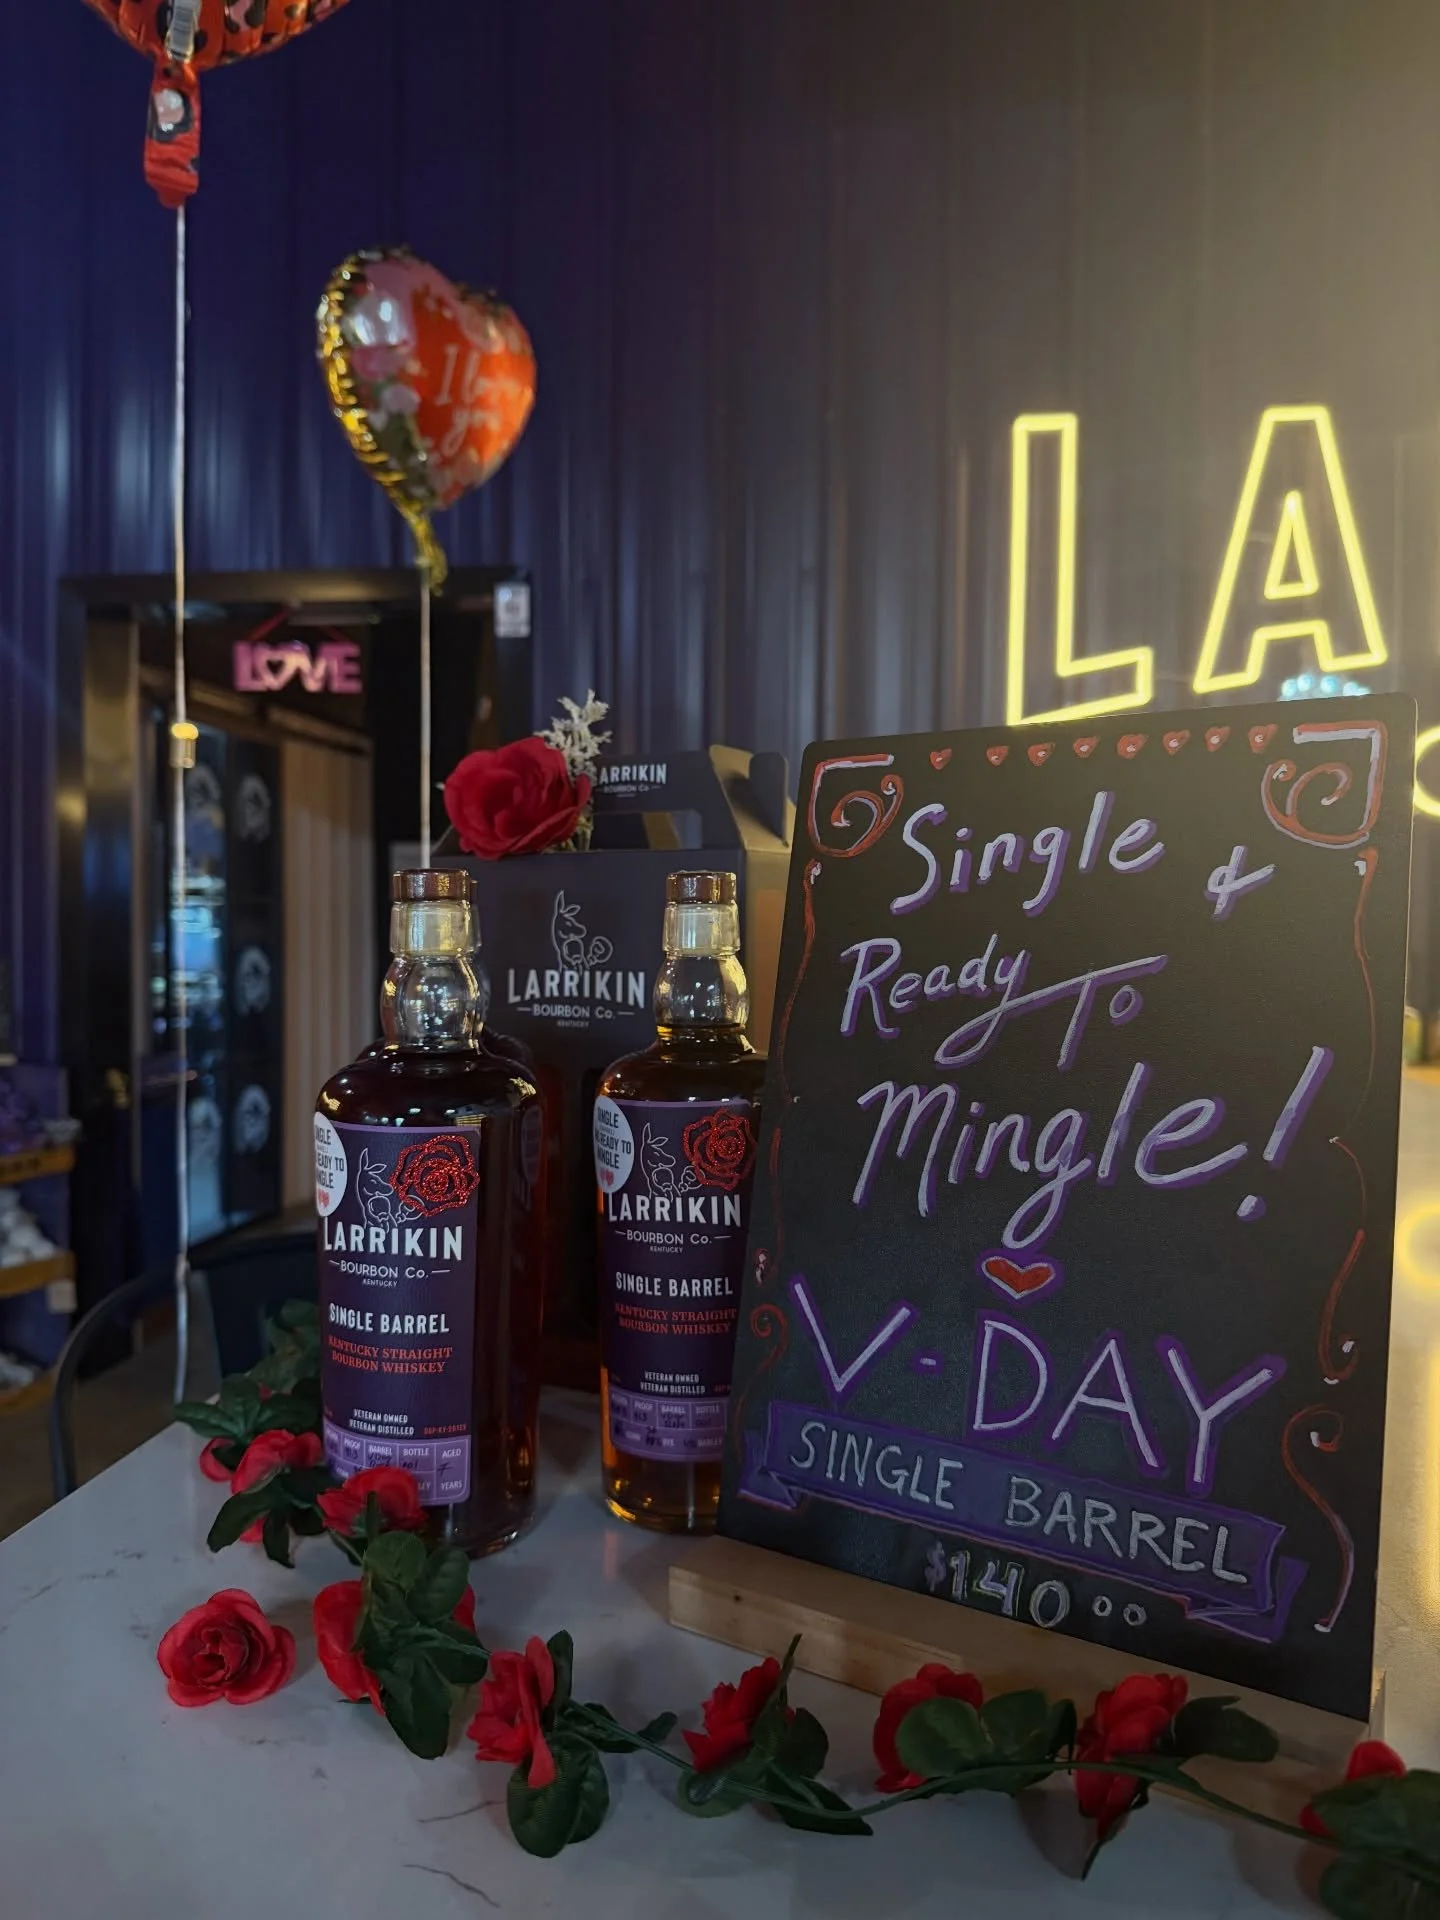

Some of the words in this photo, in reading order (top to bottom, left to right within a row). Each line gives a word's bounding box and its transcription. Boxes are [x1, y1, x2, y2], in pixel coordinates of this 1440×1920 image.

[233, 641, 362, 693] LOVE
[599, 763, 668, 785] ARRIKIN
[890, 791, 1164, 914] Single
[507, 968, 645, 1009] LARRIKIN
[532, 1004, 590, 1018] BOURBON
[839, 933, 1033, 1067] Ready
[1045, 954, 1168, 1071] To
[621, 1140, 632, 1154] TO
[852, 1046, 1334, 1252] Mingle!
[317, 1152, 333, 1169] EADY
[334, 1157, 345, 1172] TO
[608, 1192, 741, 1227] LARRIKIN
[323, 1216, 463, 1261] LARRIKIN
[626, 1229, 684, 1245] BOURBON
[340, 1261, 399, 1279] BOURBON
[362, 1278, 398, 1288] KENTUCKY
[615, 1271, 662, 1297] SINGLE
[669, 1277, 733, 1297] BARREL
[329, 1302, 374, 1333] SINGLE
[380, 1313, 450, 1334] BARREL
[614, 1302, 669, 1321] KENTUCKY
[672, 1307, 737, 1322] STRAIGHT
[618, 1317, 669, 1335] BOURBON
[673, 1321, 731, 1335] WHISKEY
[327, 1334, 379, 1359] KENTUCKY
[382, 1346, 453, 1360] STRAIGHT
[332, 1350, 379, 1373] BOURBON
[382, 1360, 446, 1374] WHISKEY
[644, 1370, 673, 1383] VETERAN
[675, 1373, 700, 1384] OWNED
[792, 1280, 1276, 1486] V-DAY
[640, 1382, 668, 1395] VETERAN
[670, 1384, 706, 1396] DISTILLED
[353, 1408, 382, 1422] VETERAN
[383, 1413, 409, 1425] OWNED
[349, 1419, 377, 1433] VETERAN
[378, 1424, 415, 1436] DISTILLED
[368, 1444, 393, 1457] BARREL
[403, 1446, 430, 1457] BOTTLE
[441, 1448, 462, 1459] AGED
[440, 1480, 463, 1492] YEARS
[789, 1420, 965, 1511] SINGLE
[1004, 1475, 1249, 1585] BARREL
